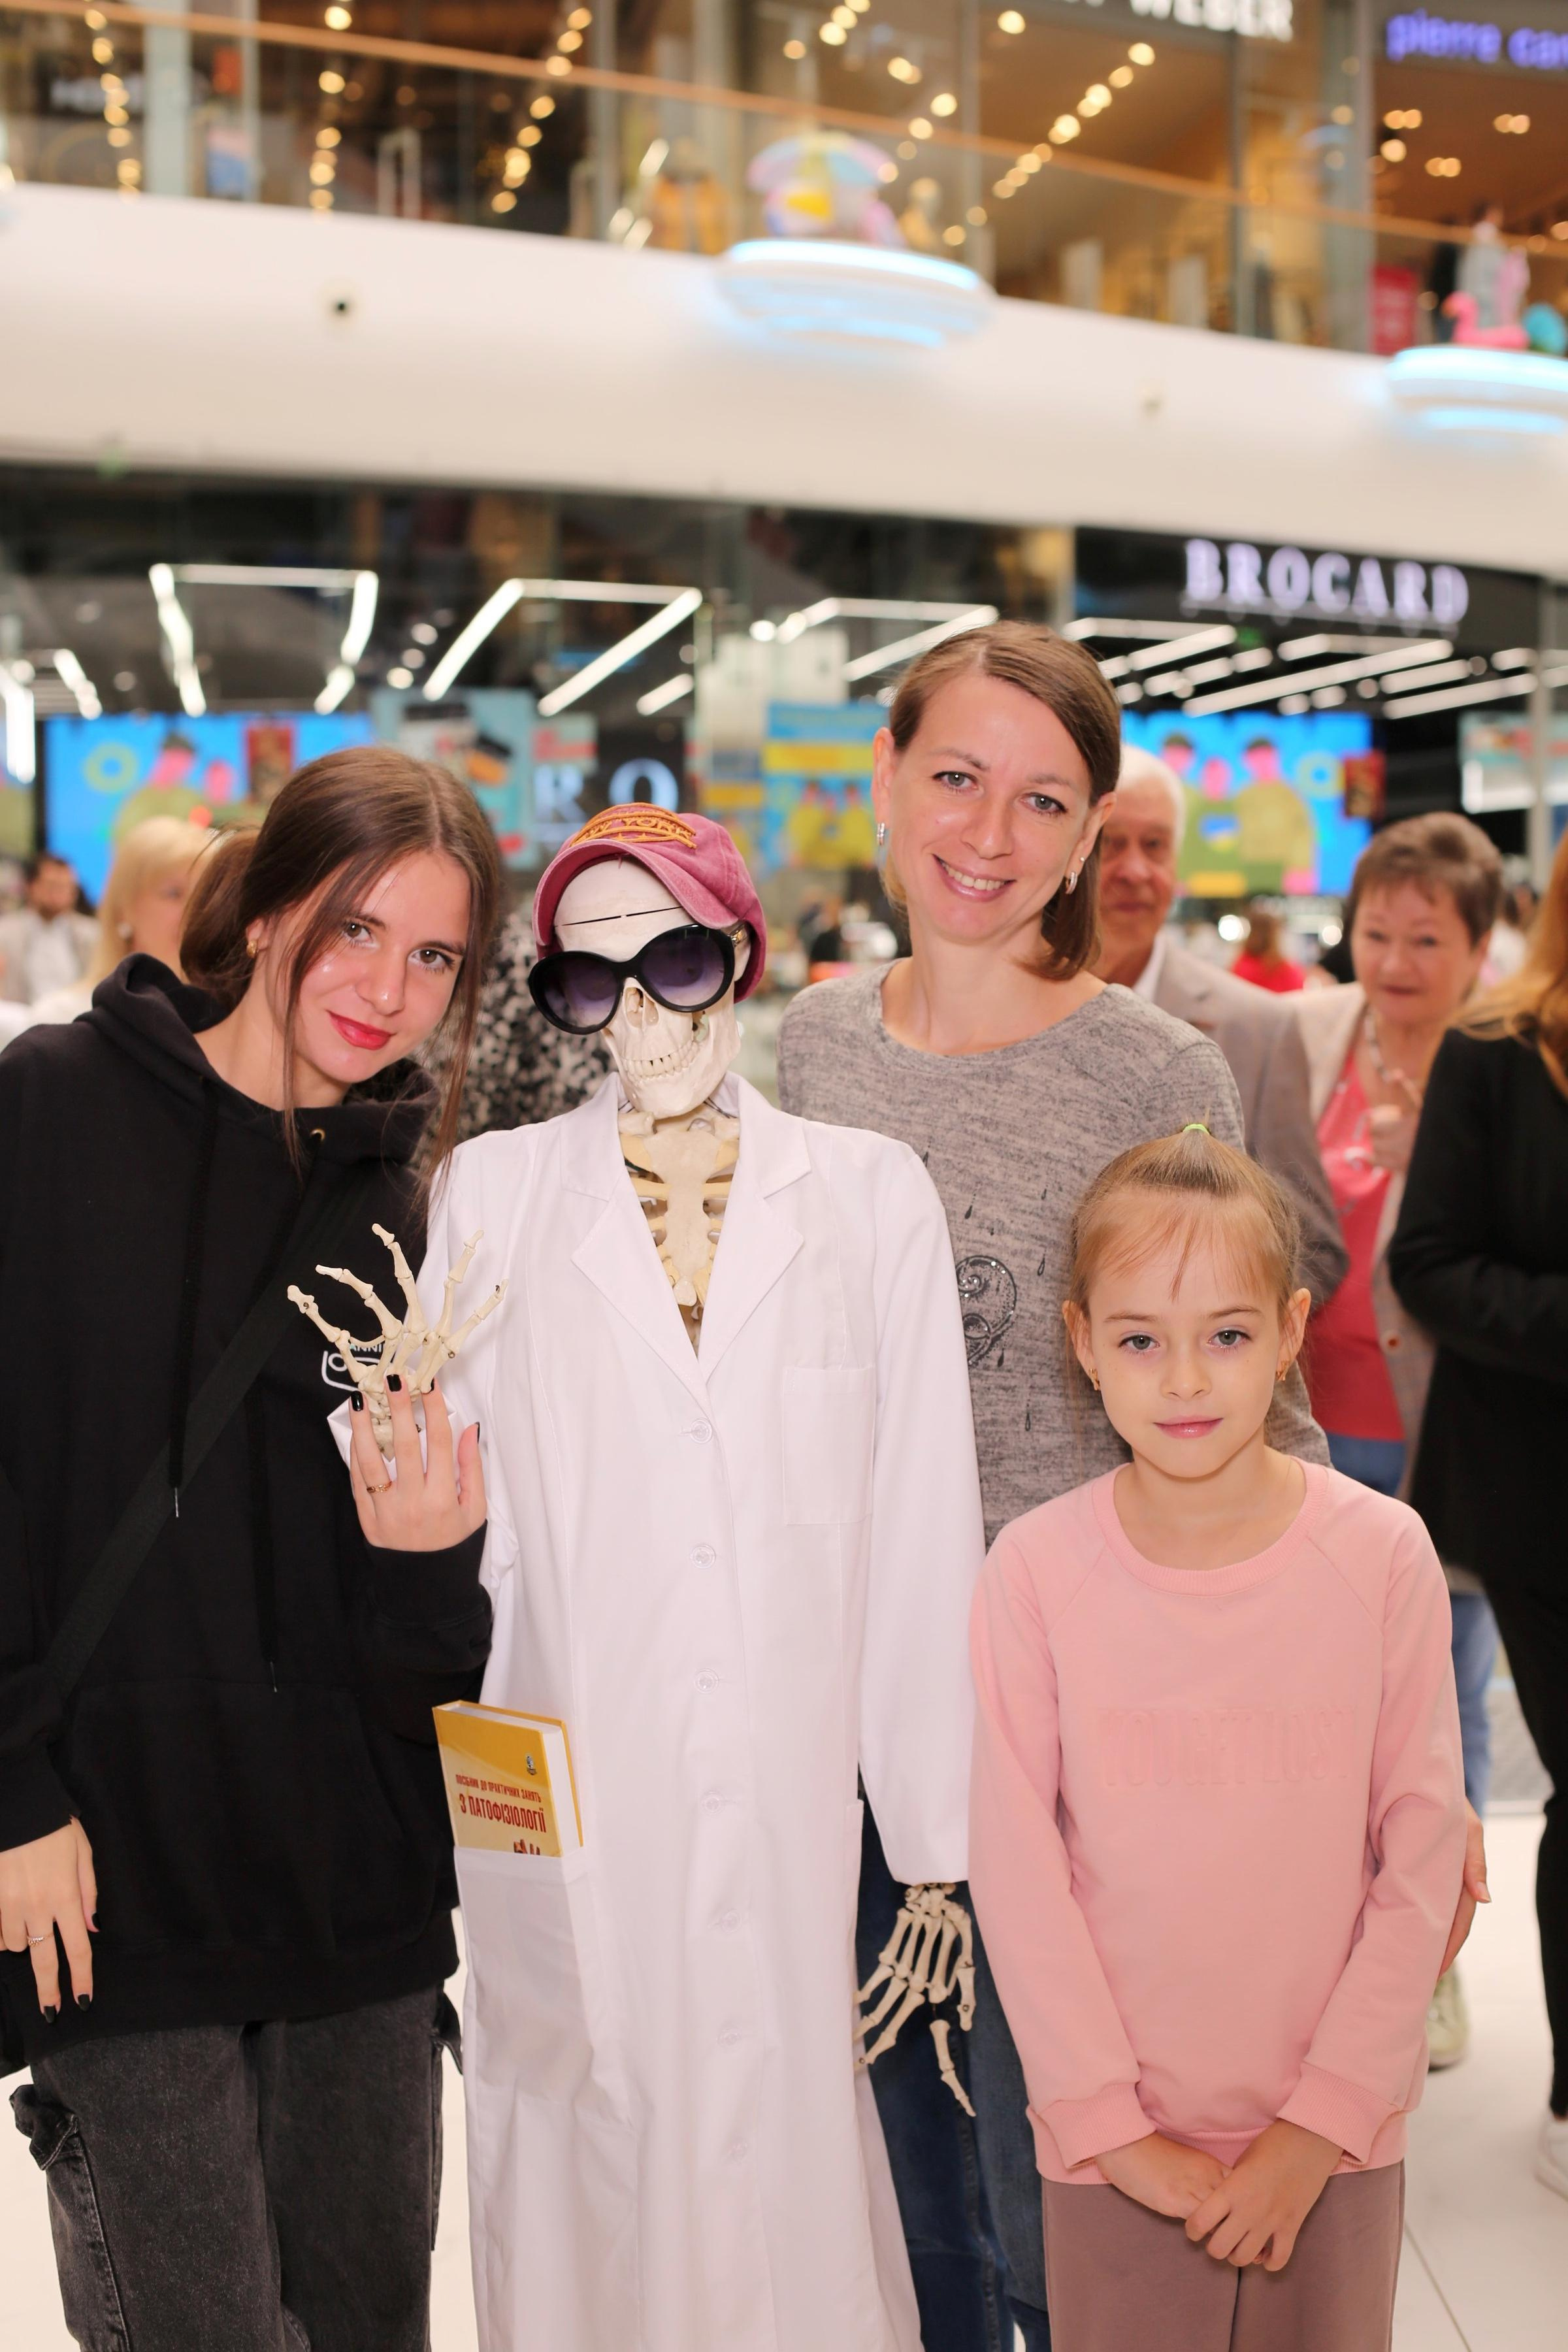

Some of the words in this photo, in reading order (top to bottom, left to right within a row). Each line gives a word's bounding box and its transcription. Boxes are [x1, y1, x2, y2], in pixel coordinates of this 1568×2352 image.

[1185, 538, 1469, 625] BROCARD
[621, 817, 693, 841] YORK
[1183, 1707, 1254, 1786] GET
[1261, 1706, 1358, 1784] LOST
[480, 1780, 487, 1791] ДО
[487, 1782, 520, 1797] ПРАКТИЧНИХ
[521, 1789, 542, 1803] ЗАНЯТЬ
[459, 1793, 466, 1814] З
[468, 1795, 547, 1833] ПАТОФІЗІОЛОГІЇ
